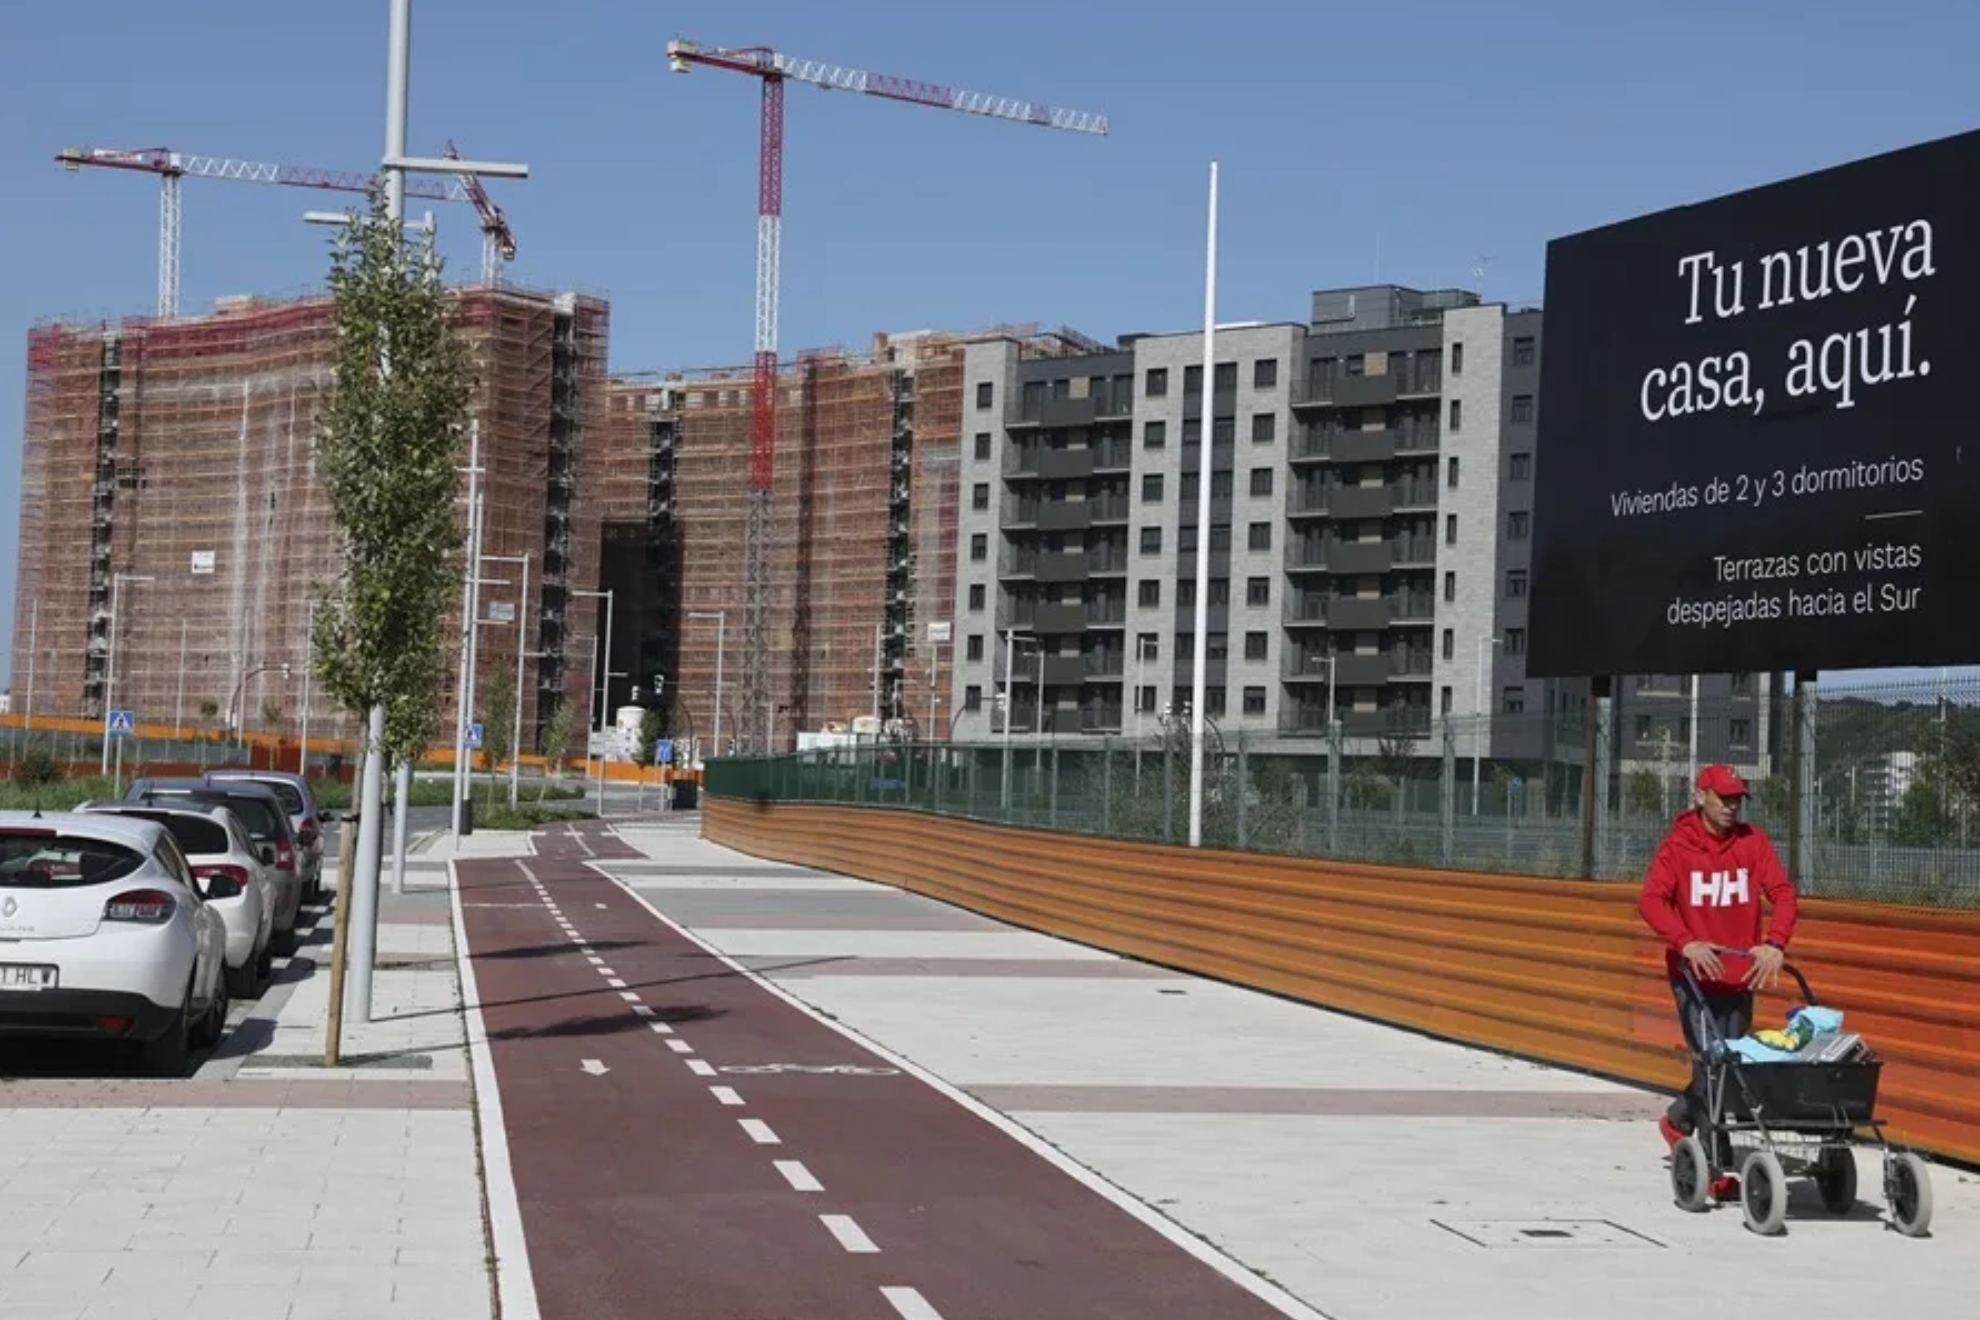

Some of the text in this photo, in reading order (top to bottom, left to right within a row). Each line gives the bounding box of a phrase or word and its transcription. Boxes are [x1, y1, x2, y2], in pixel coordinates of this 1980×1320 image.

[1678, 218, 1936, 325] Tu nueva
[1640, 293, 1931, 422] casa, aquí.
[1611, 456, 1924, 518] Viviendas de 2 y 3 dormitorios
[1714, 543, 1922, 583] Terrazas con vistas
[1667, 583, 1922, 629] despejadas hacia el Sur
[1690, 867, 1750, 907] HH
